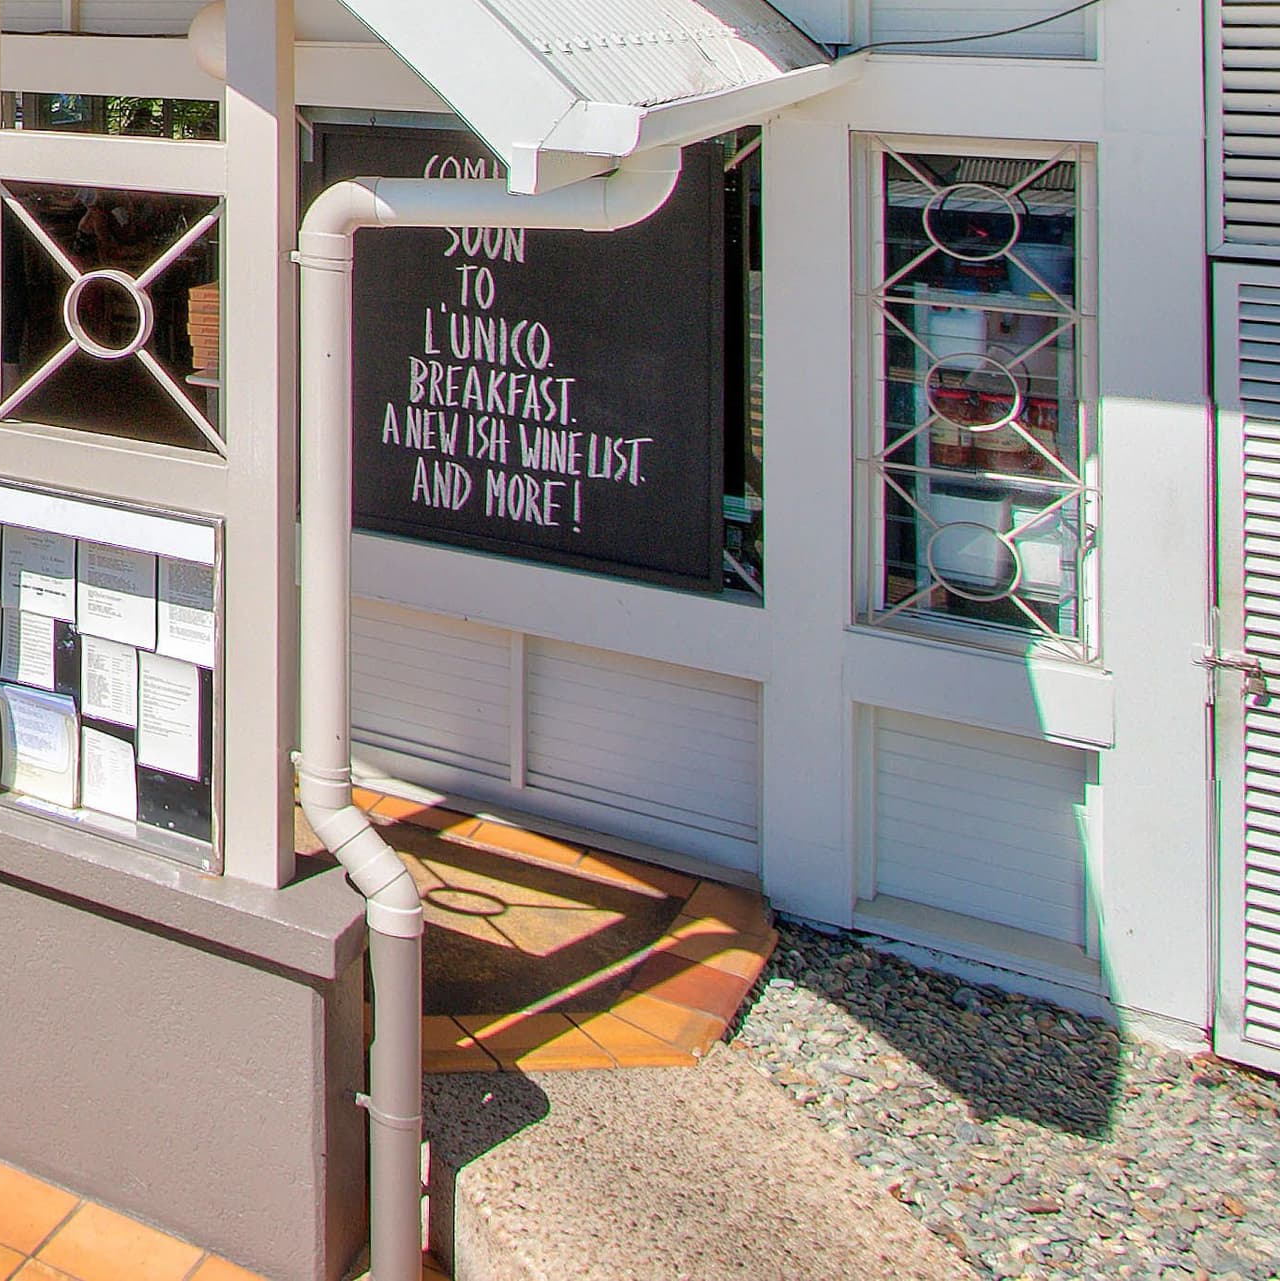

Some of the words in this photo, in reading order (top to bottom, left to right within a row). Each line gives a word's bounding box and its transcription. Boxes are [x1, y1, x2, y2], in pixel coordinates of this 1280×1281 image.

[444, 226, 526, 263] SOON
[455, 264, 496, 310] TO
[382, 402, 401, 445] A
[519, 423, 583, 476] WINE
[411, 456, 473, 511] AND
